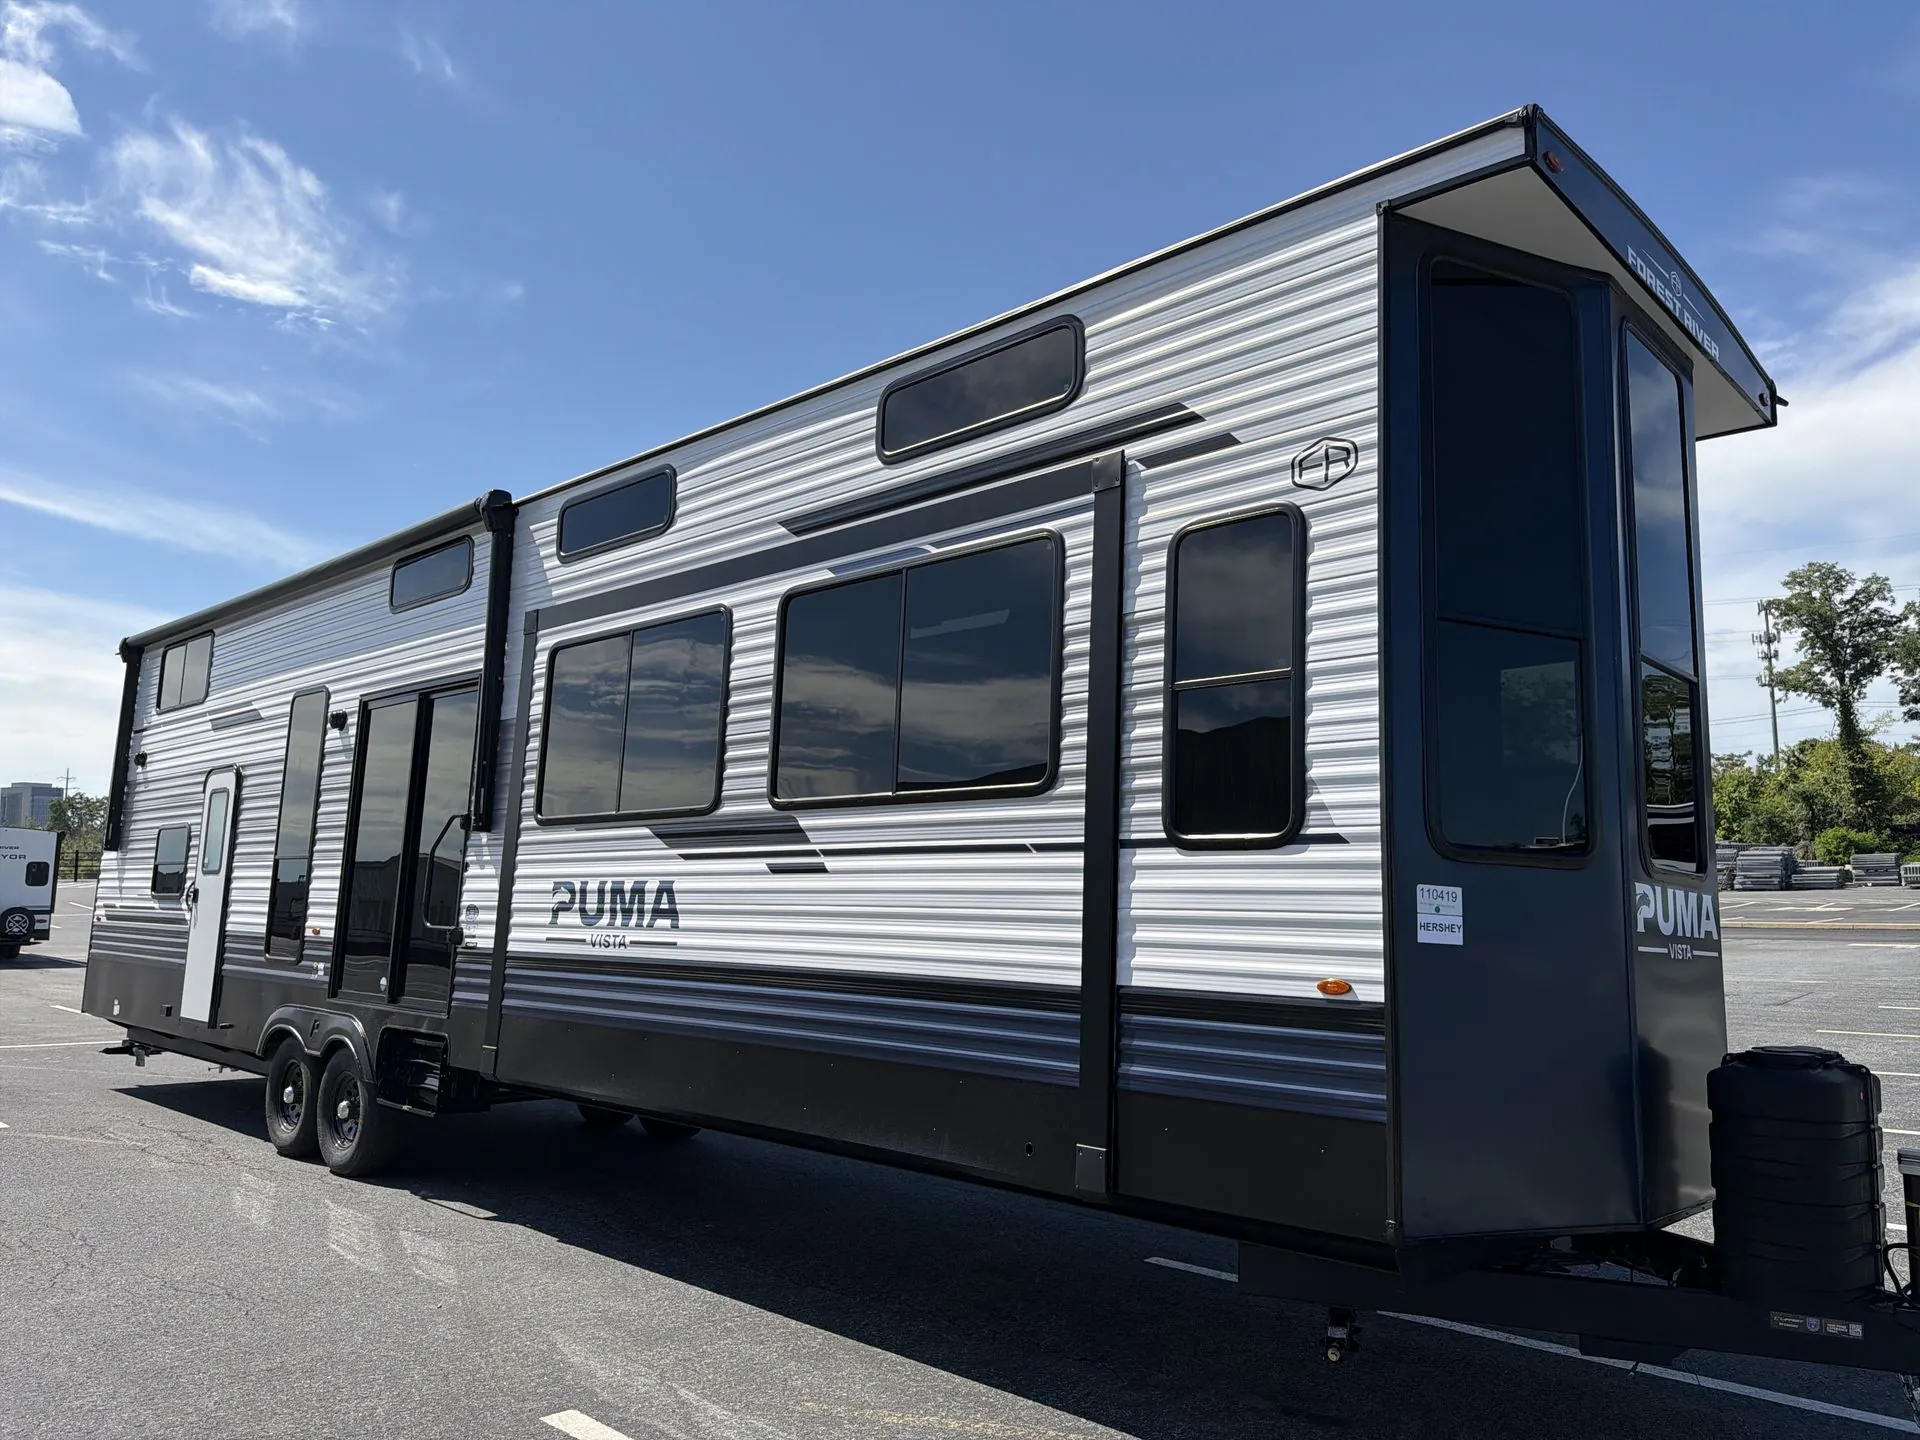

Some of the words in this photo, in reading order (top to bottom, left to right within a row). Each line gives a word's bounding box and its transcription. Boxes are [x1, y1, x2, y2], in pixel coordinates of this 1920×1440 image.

[1627, 245, 1681, 317] FOREST
[1683, 309, 1720, 360] RIVER
[1419, 887, 1458, 903] 110419
[548, 880, 680, 929] PUMA
[1634, 882, 1719, 940] PUMA
[1419, 921, 1462, 933] HERSHEY
[590, 933, 628, 949] VISTA
[1668, 943, 1693, 960] VISTA
